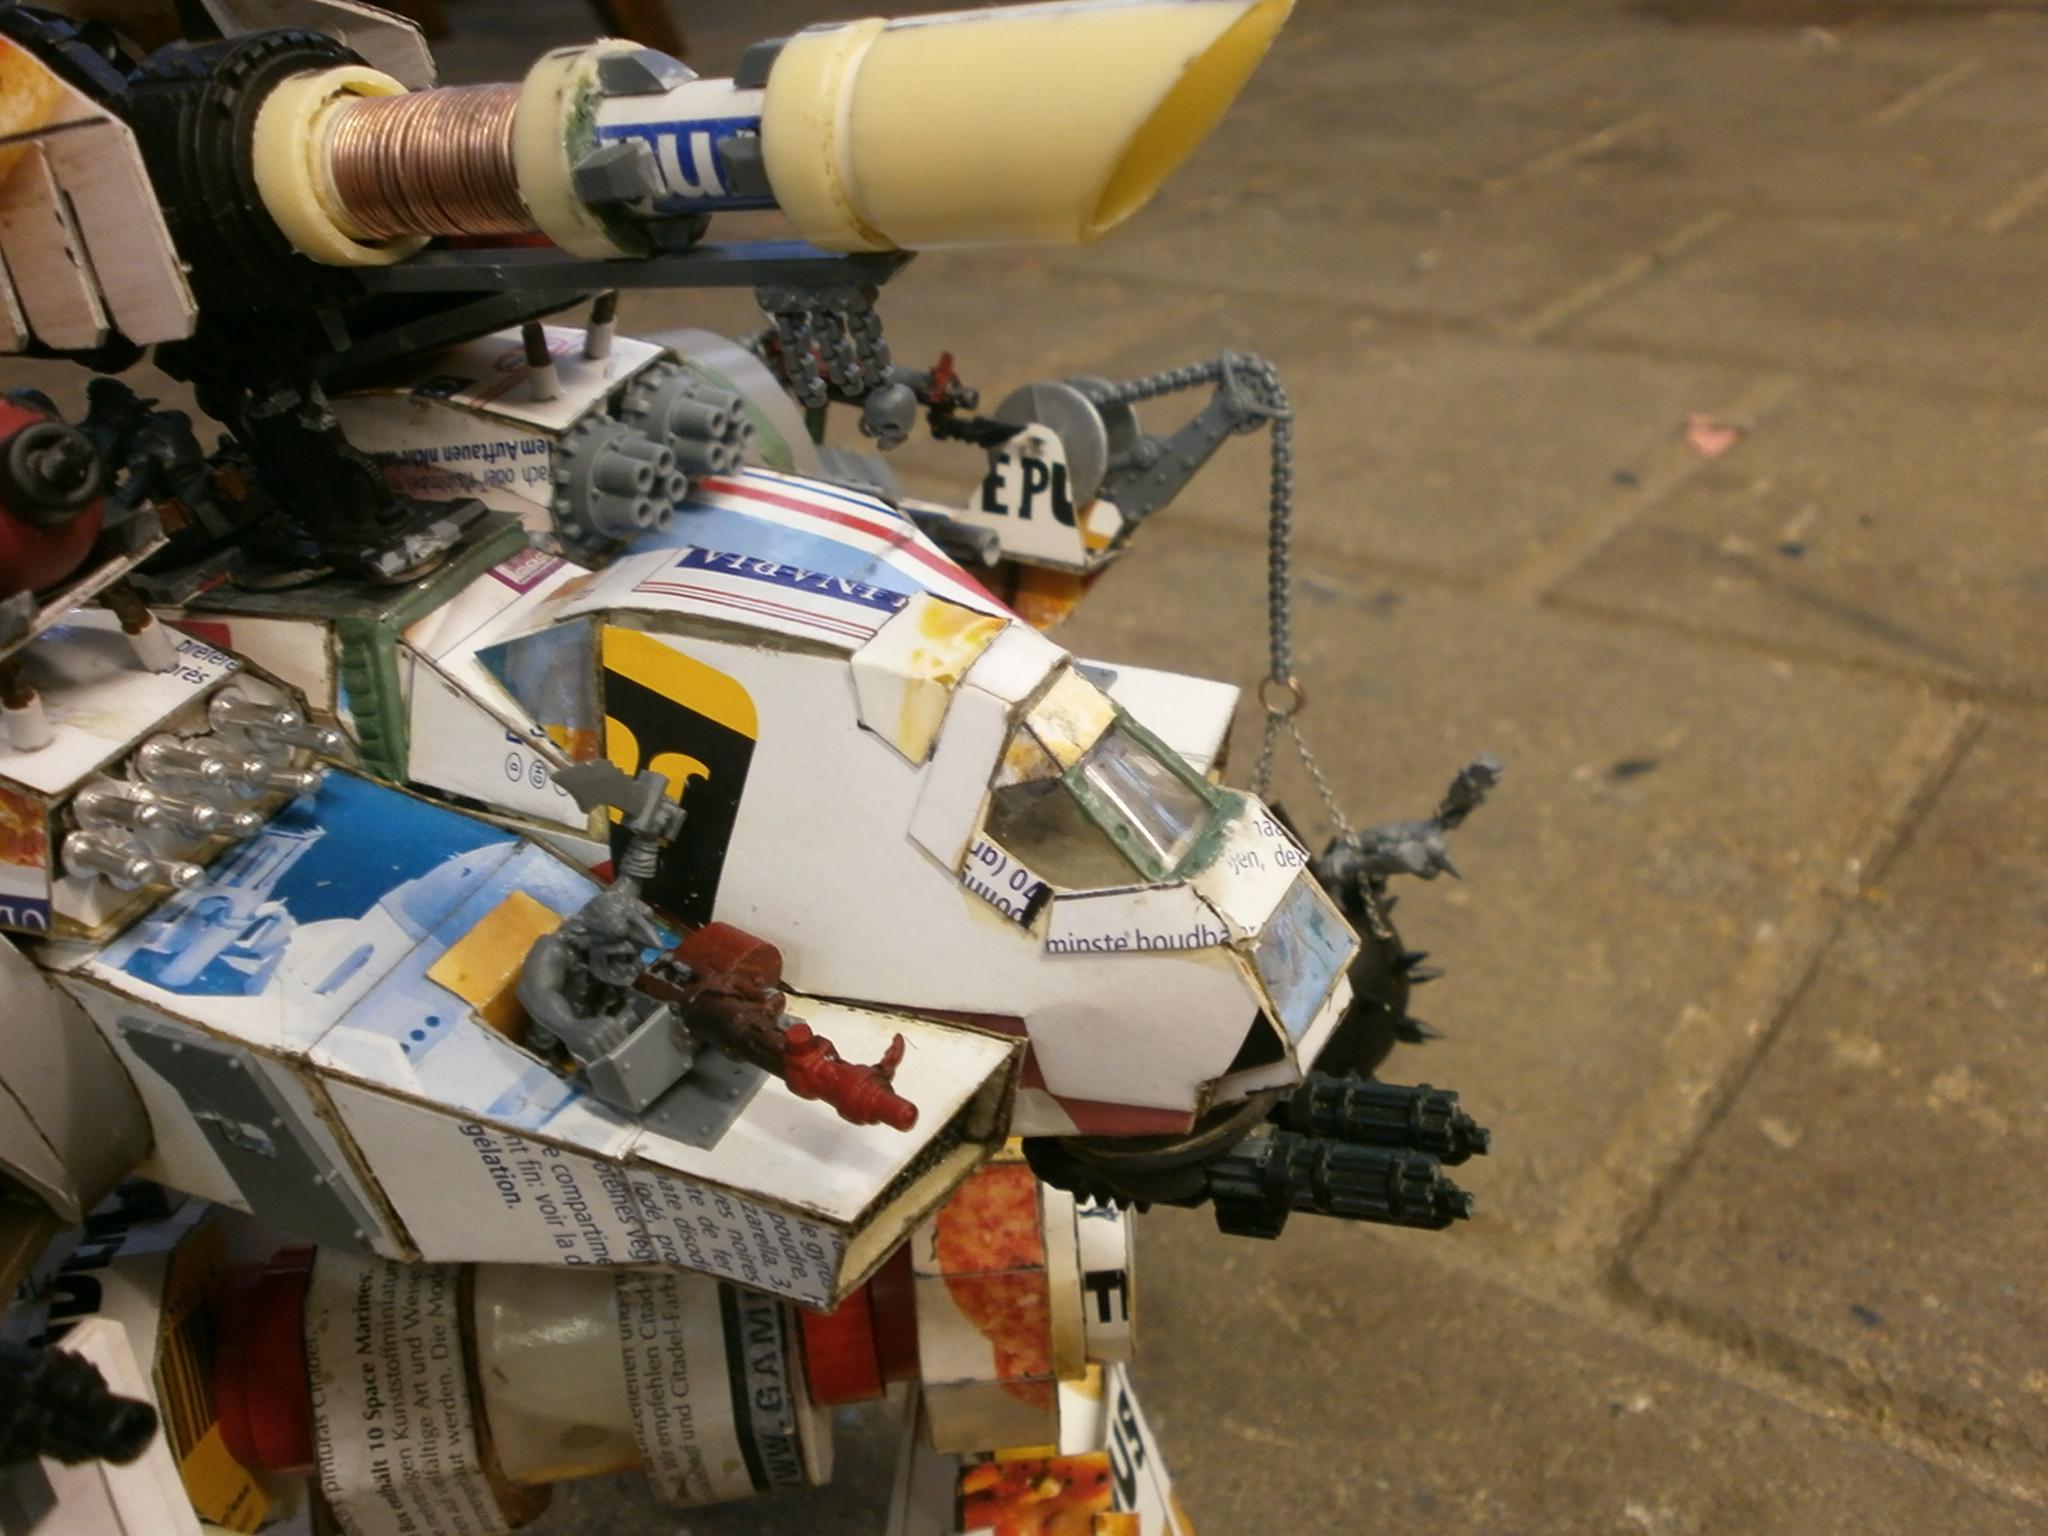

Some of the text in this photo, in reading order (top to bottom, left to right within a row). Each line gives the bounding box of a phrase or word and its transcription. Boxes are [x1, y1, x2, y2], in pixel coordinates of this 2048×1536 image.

[458, 1121, 522, 1210] gélation.
[536, 1192, 565, 1226] voir
[553, 1235, 577, 1250] la
[402, 1336, 426, 1374] und
[428, 1325, 449, 1360] Die
[359, 1362, 385, 1420] Space
[413, 1380, 432, 1410] Art
[643, 1345, 673, 1446] empfehlen
[368, 1427, 385, 1449] 10
[673, 1404, 695, 1440] und
